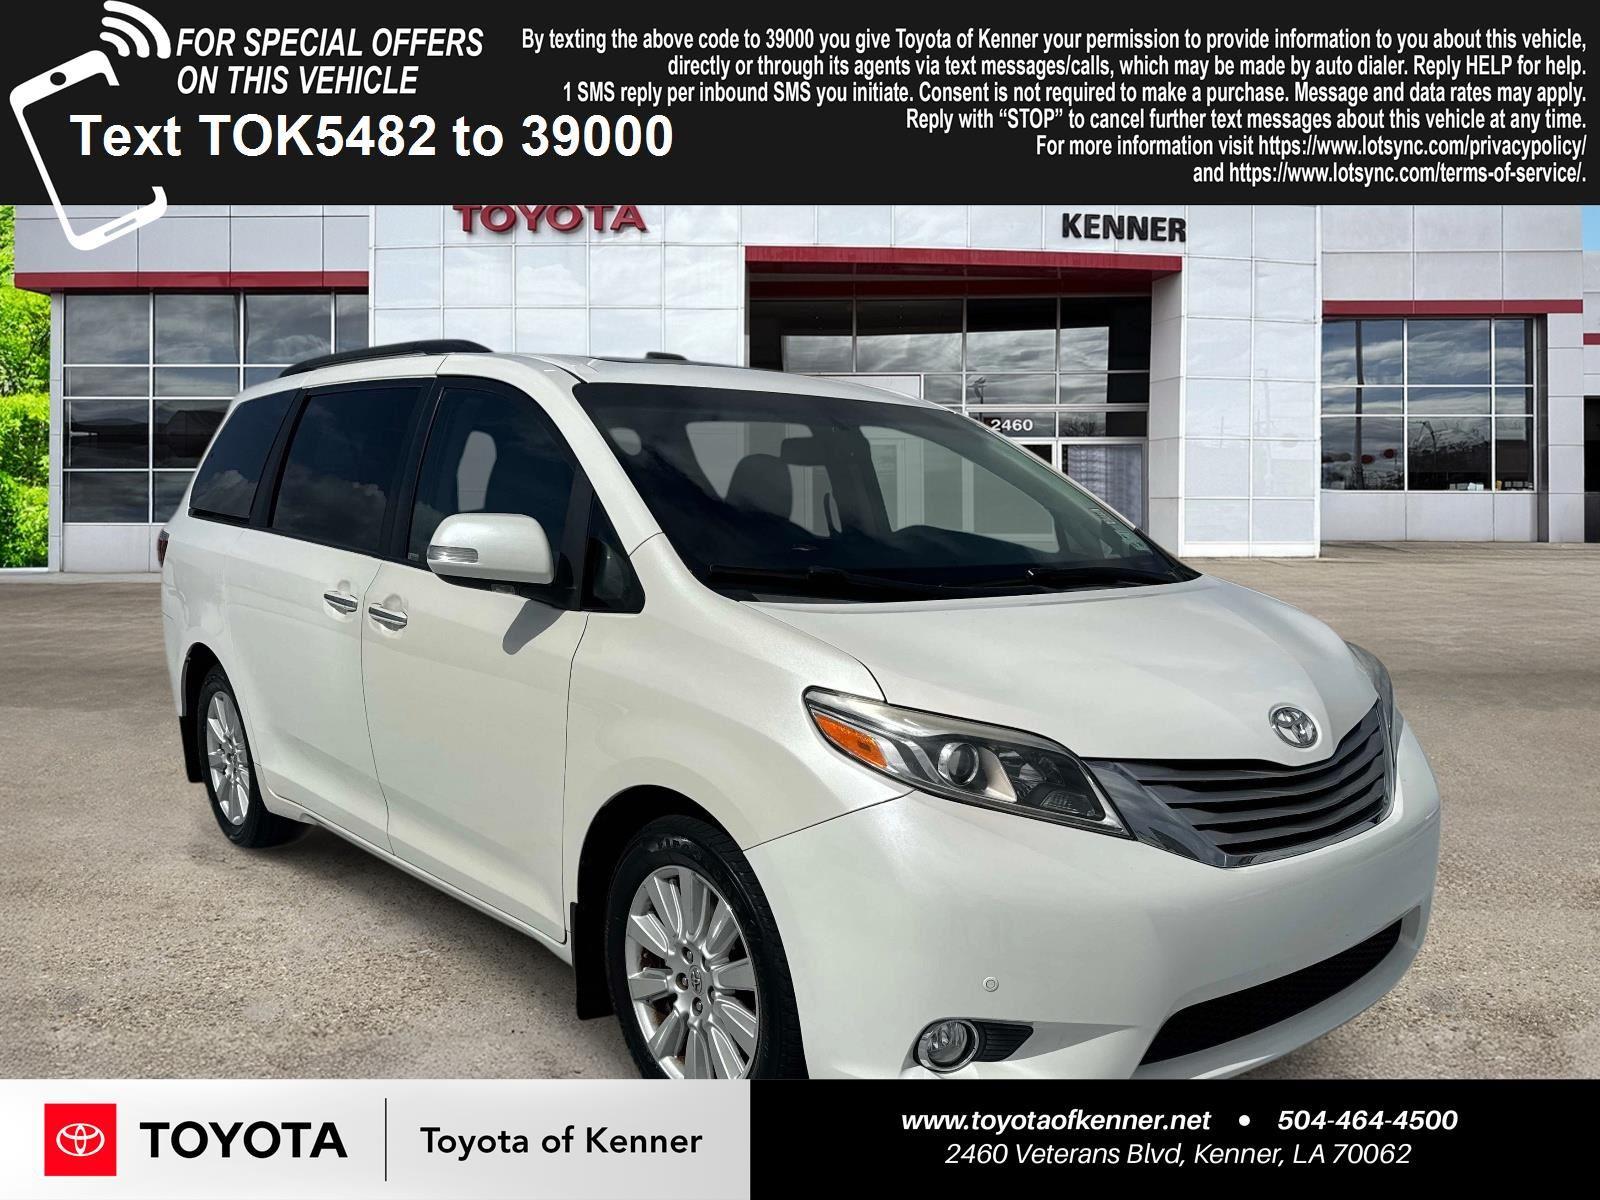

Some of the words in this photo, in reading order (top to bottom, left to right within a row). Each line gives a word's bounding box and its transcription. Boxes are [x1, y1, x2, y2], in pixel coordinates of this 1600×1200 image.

[453, 205, 647, 233] TOYOTA
[1062, 213, 1187, 242] KENNER
[991, 419, 1034, 432] 2460
